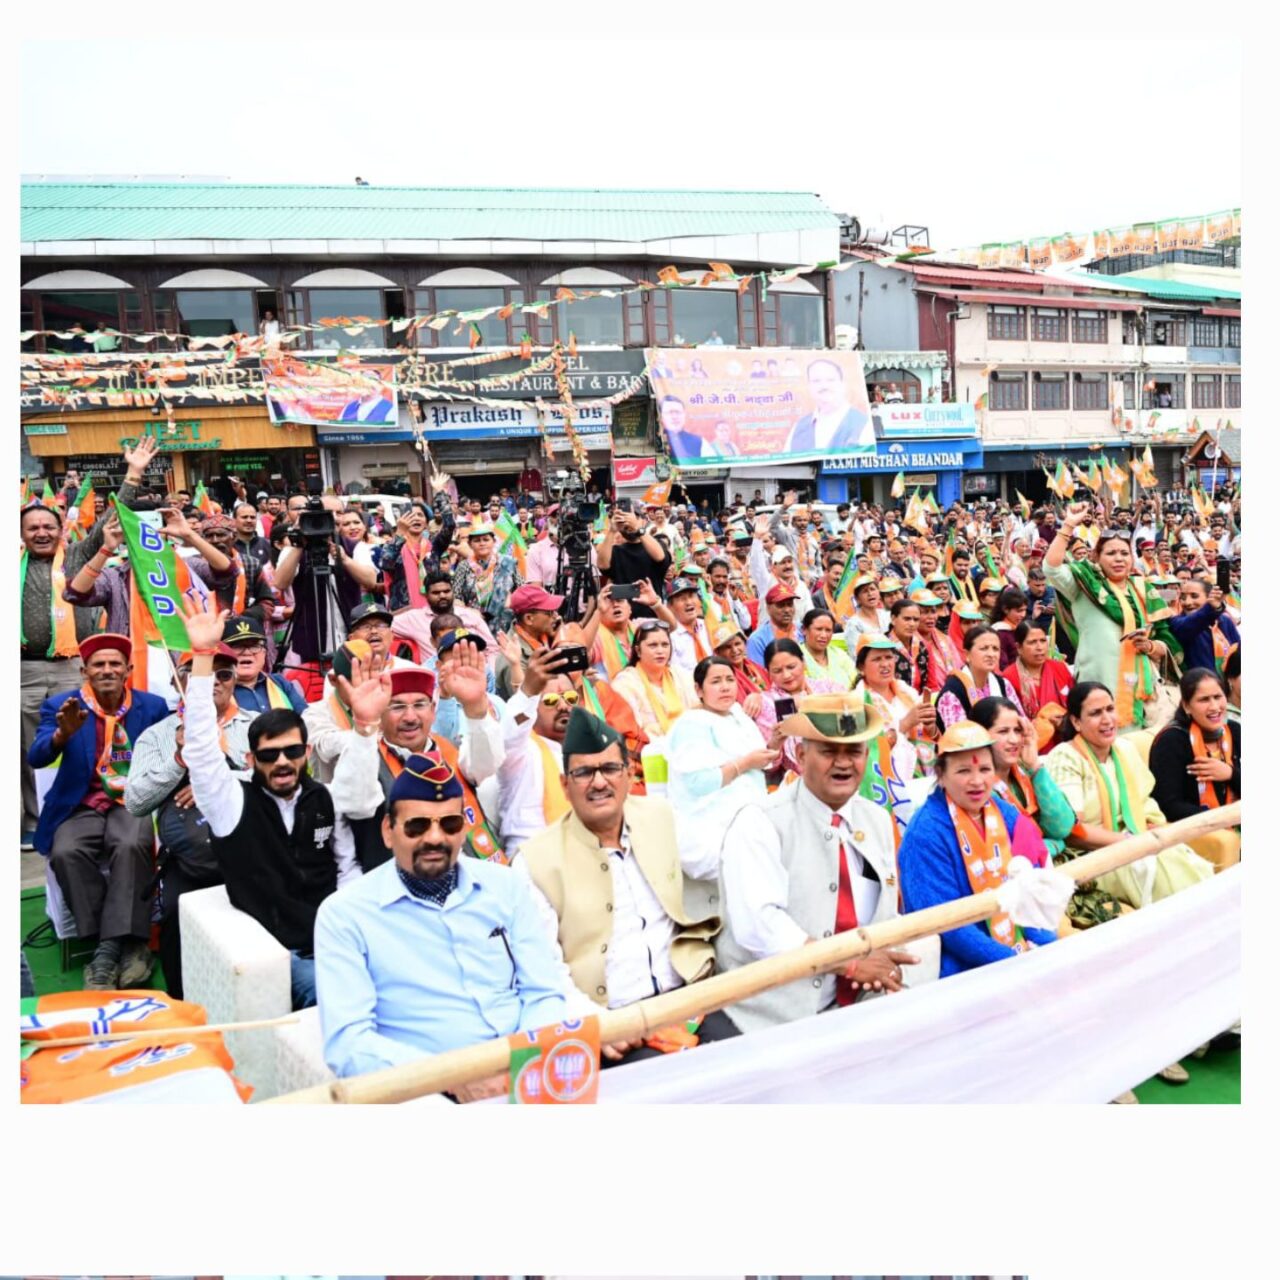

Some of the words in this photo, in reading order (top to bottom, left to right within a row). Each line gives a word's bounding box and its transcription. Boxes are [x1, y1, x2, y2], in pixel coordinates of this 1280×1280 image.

[431, 406, 522, 427] Prakash
[822, 458, 857, 469] LAXMI
[861, 454, 909, 468] MISTHAN
[912, 452, 964, 467] BHANDAR
